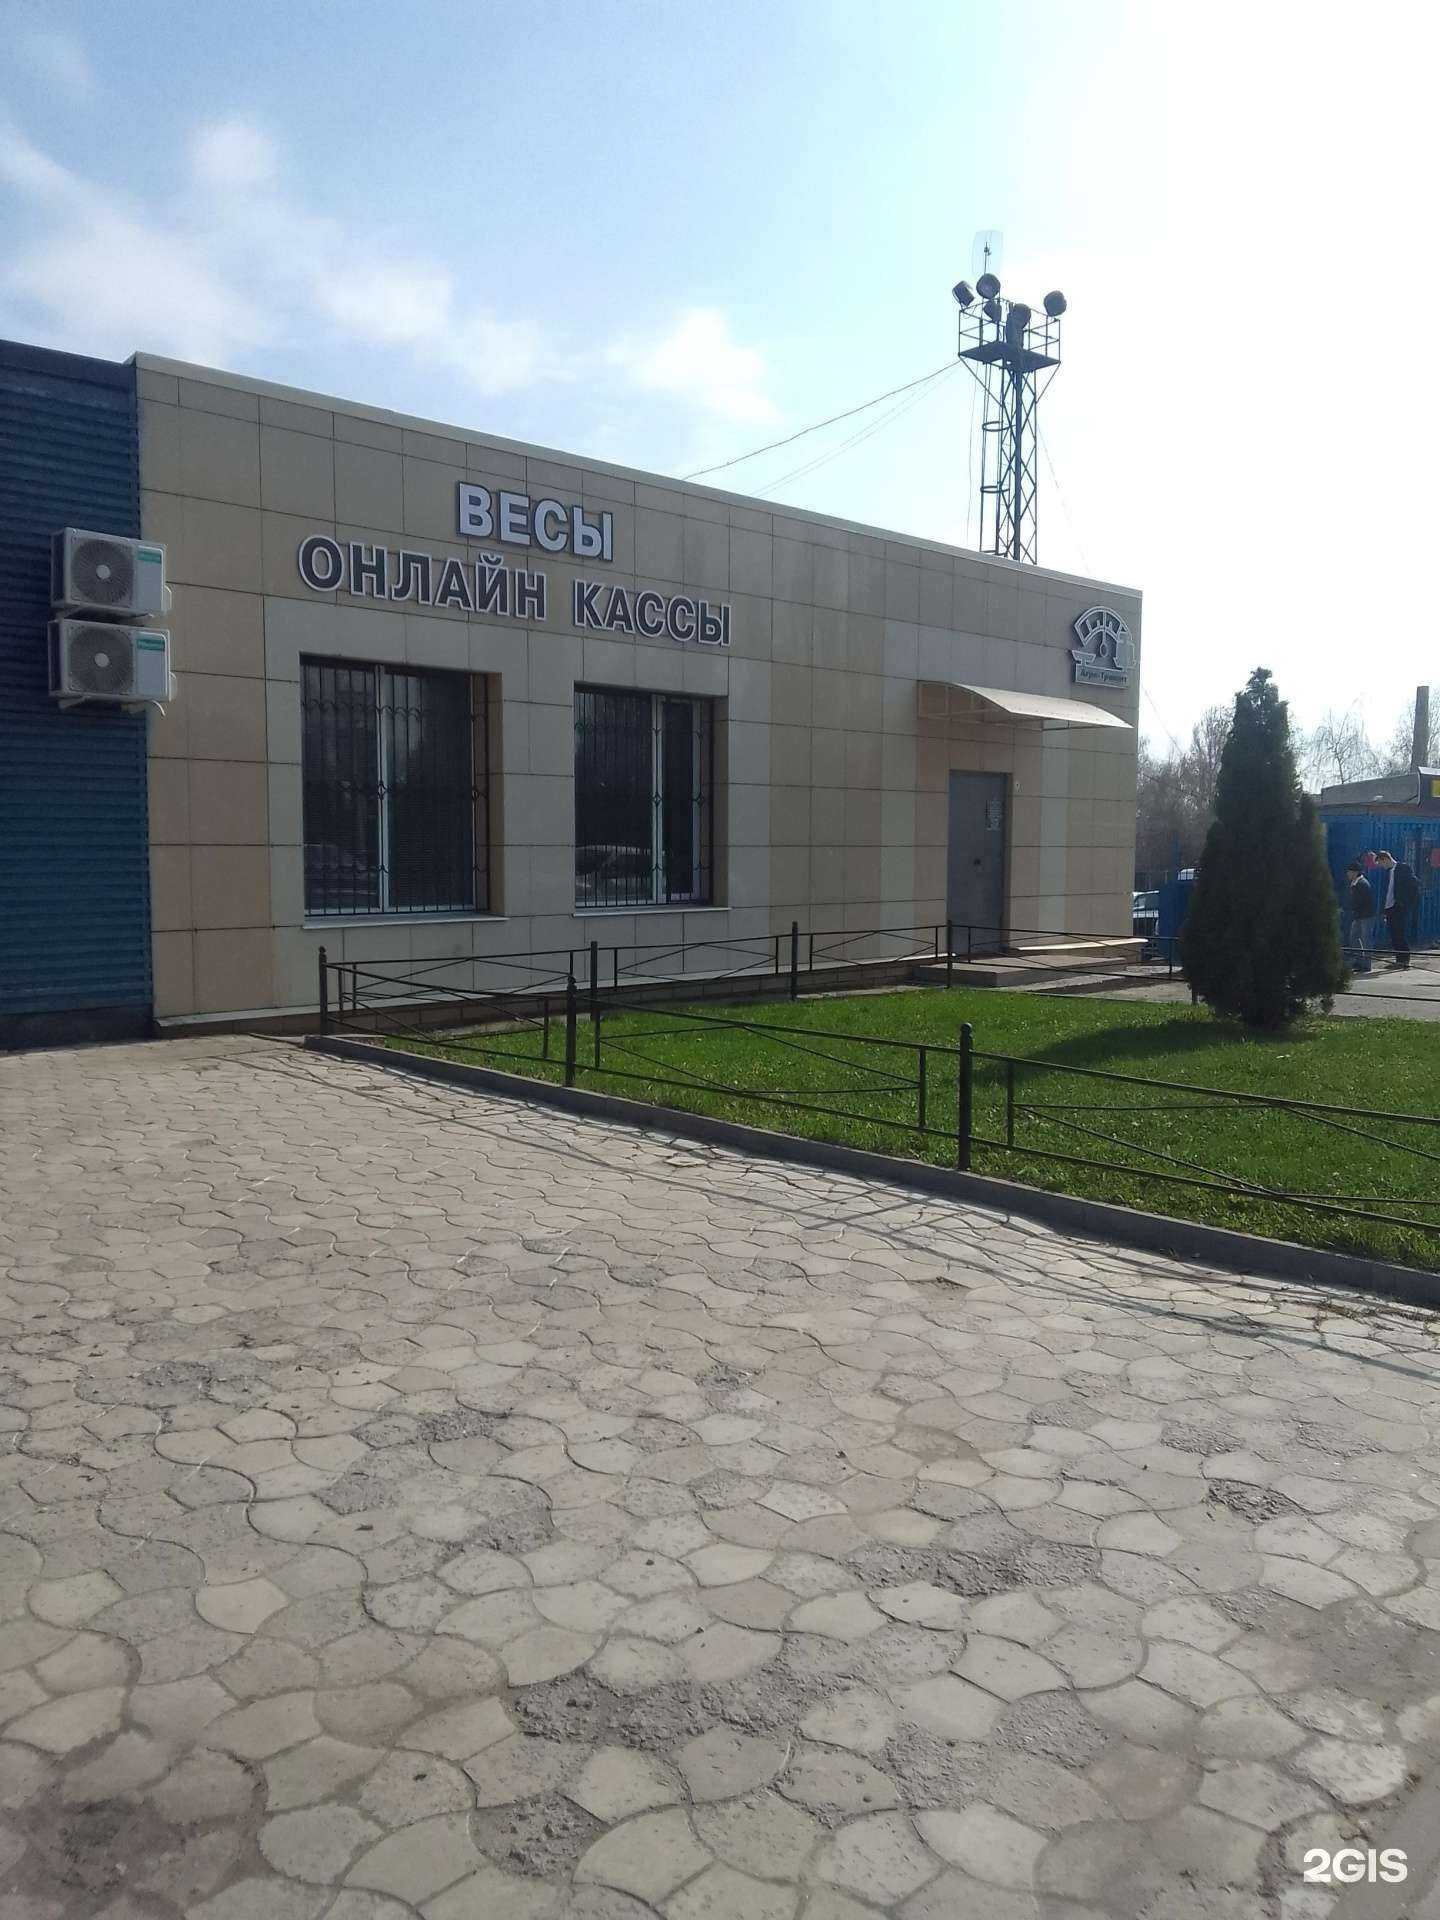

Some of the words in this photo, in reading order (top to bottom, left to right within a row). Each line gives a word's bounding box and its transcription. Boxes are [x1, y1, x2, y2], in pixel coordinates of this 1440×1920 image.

[457, 481, 613, 562] ВЕСЫ
[298, 535, 547, 621] ОНЛАЙН
[573, 578, 731, 647] КАССЫ
